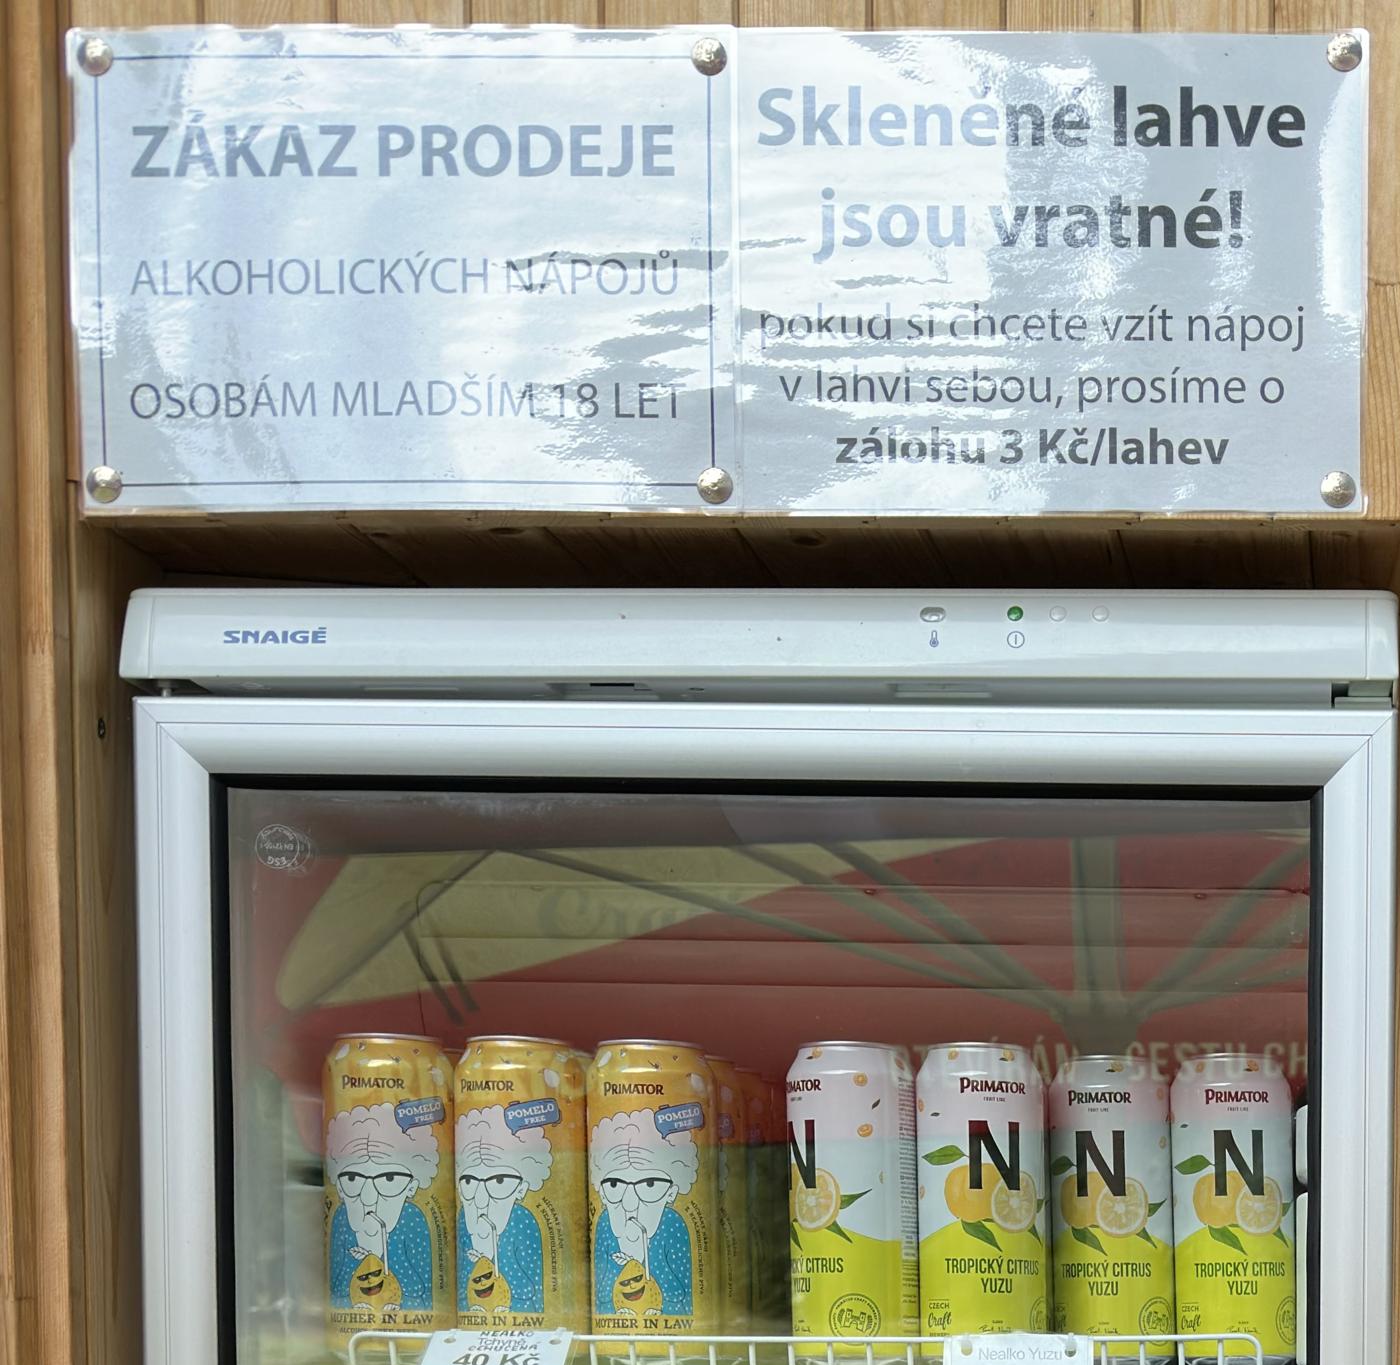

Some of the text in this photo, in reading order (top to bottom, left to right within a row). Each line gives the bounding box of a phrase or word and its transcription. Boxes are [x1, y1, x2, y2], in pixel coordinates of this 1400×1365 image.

[757, 85, 1306, 148] Skleněné lahve
[131, 112, 675, 178] ZÁKAZ PRODEJE
[813, 188, 1244, 264] jsou vratné!
[132, 250, 679, 297] ALKOHOLICKÝCH NÁPOJŮ
[760, 303, 1304, 351] pokud si chcete vzít nápoj
[130, 372, 681, 420] OSOBÁM MLADŠÍM 18 LET
[779, 365, 1285, 413] v lahvi sebou, prosíme o
[836, 428, 1229, 467] zálohu 3 Kč/lahev
[507, 1103, 555, 1120] POMELO
[525, 1115, 546, 1125] FREE
[968, 1120, 1021, 1191] N
[945, 1255, 1039, 1274] TROPICKÝ CITRUS
[981, 1278, 1012, 1294] YUZU
[594, 1318, 693, 1329] MOTHER IN LAW
[979, 1347, 1065, 1360] Nealko Yuzu
